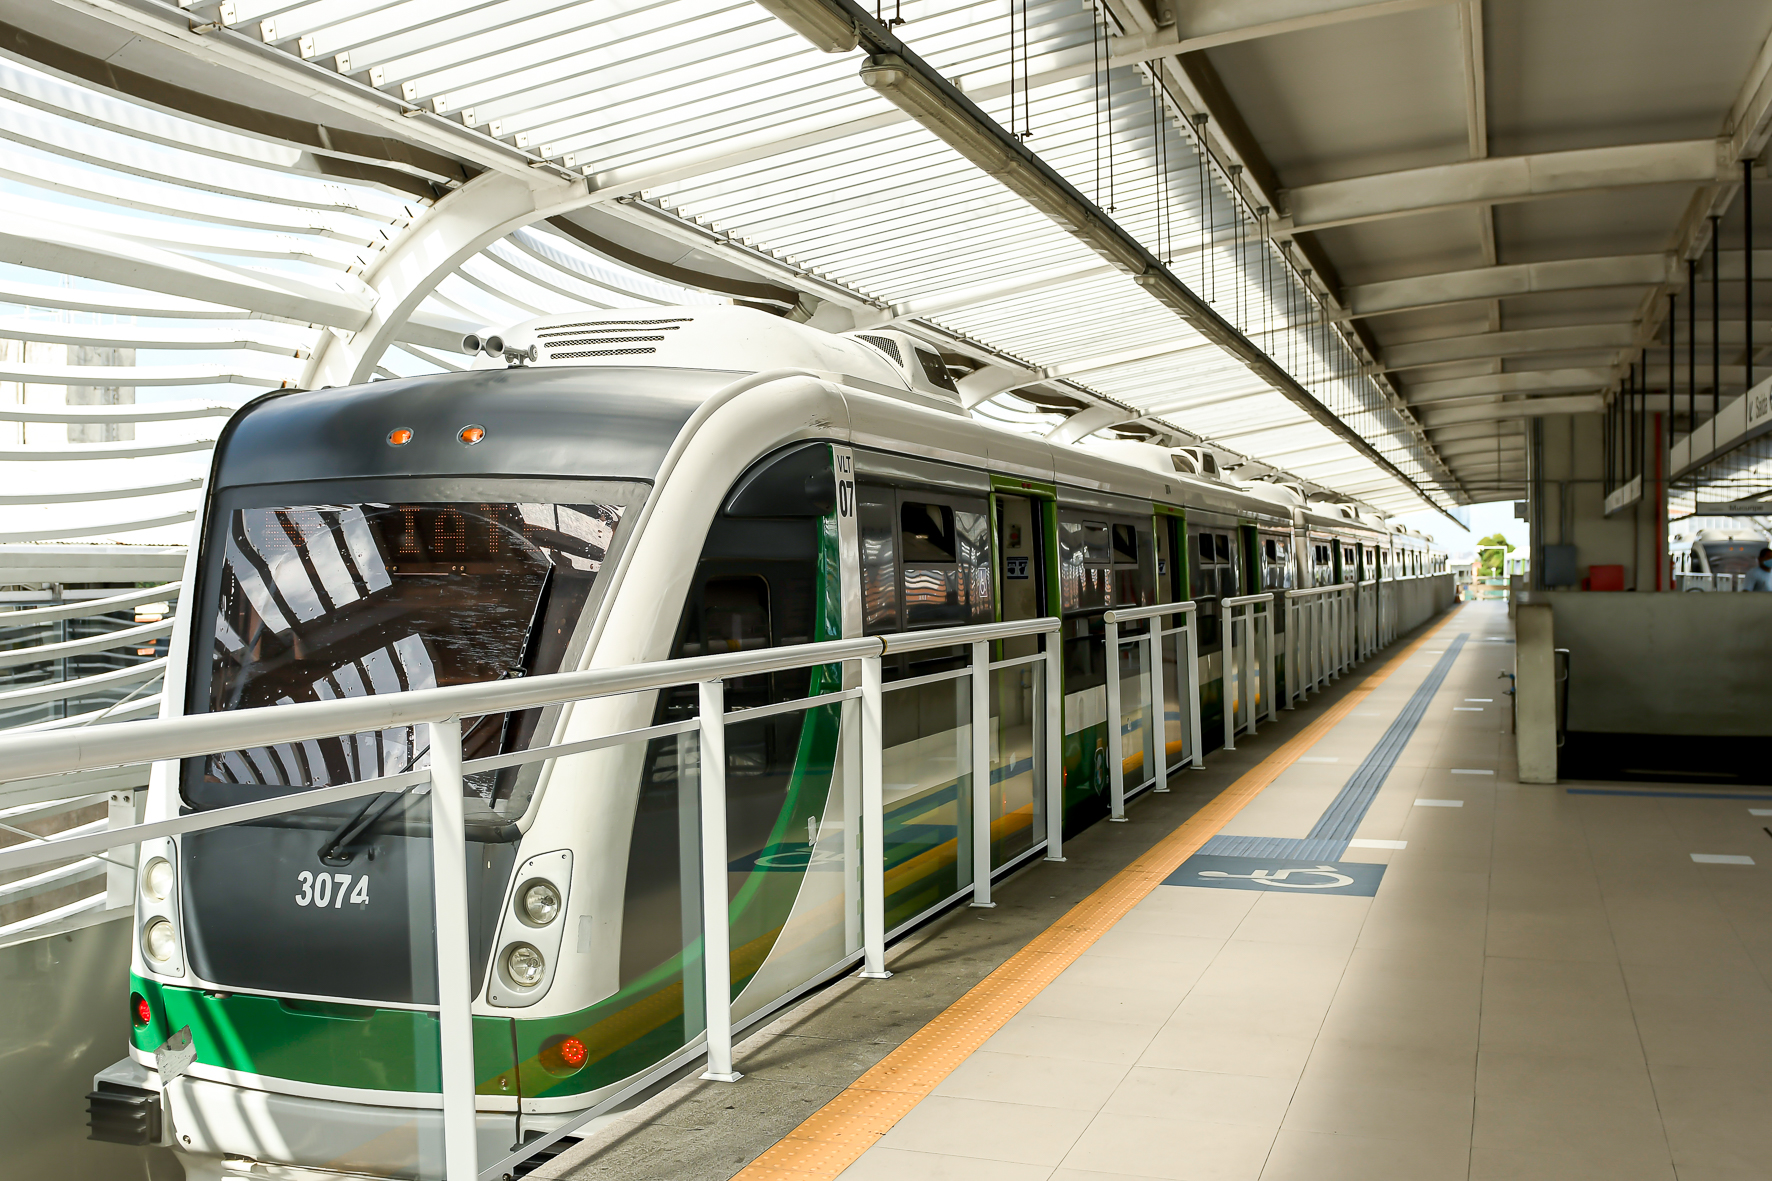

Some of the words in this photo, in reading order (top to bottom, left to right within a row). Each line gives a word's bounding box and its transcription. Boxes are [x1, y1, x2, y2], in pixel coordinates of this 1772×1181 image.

[837, 455, 851, 473] VLT
[839, 480, 853, 517] 07
[295, 870, 370, 909] 3074
